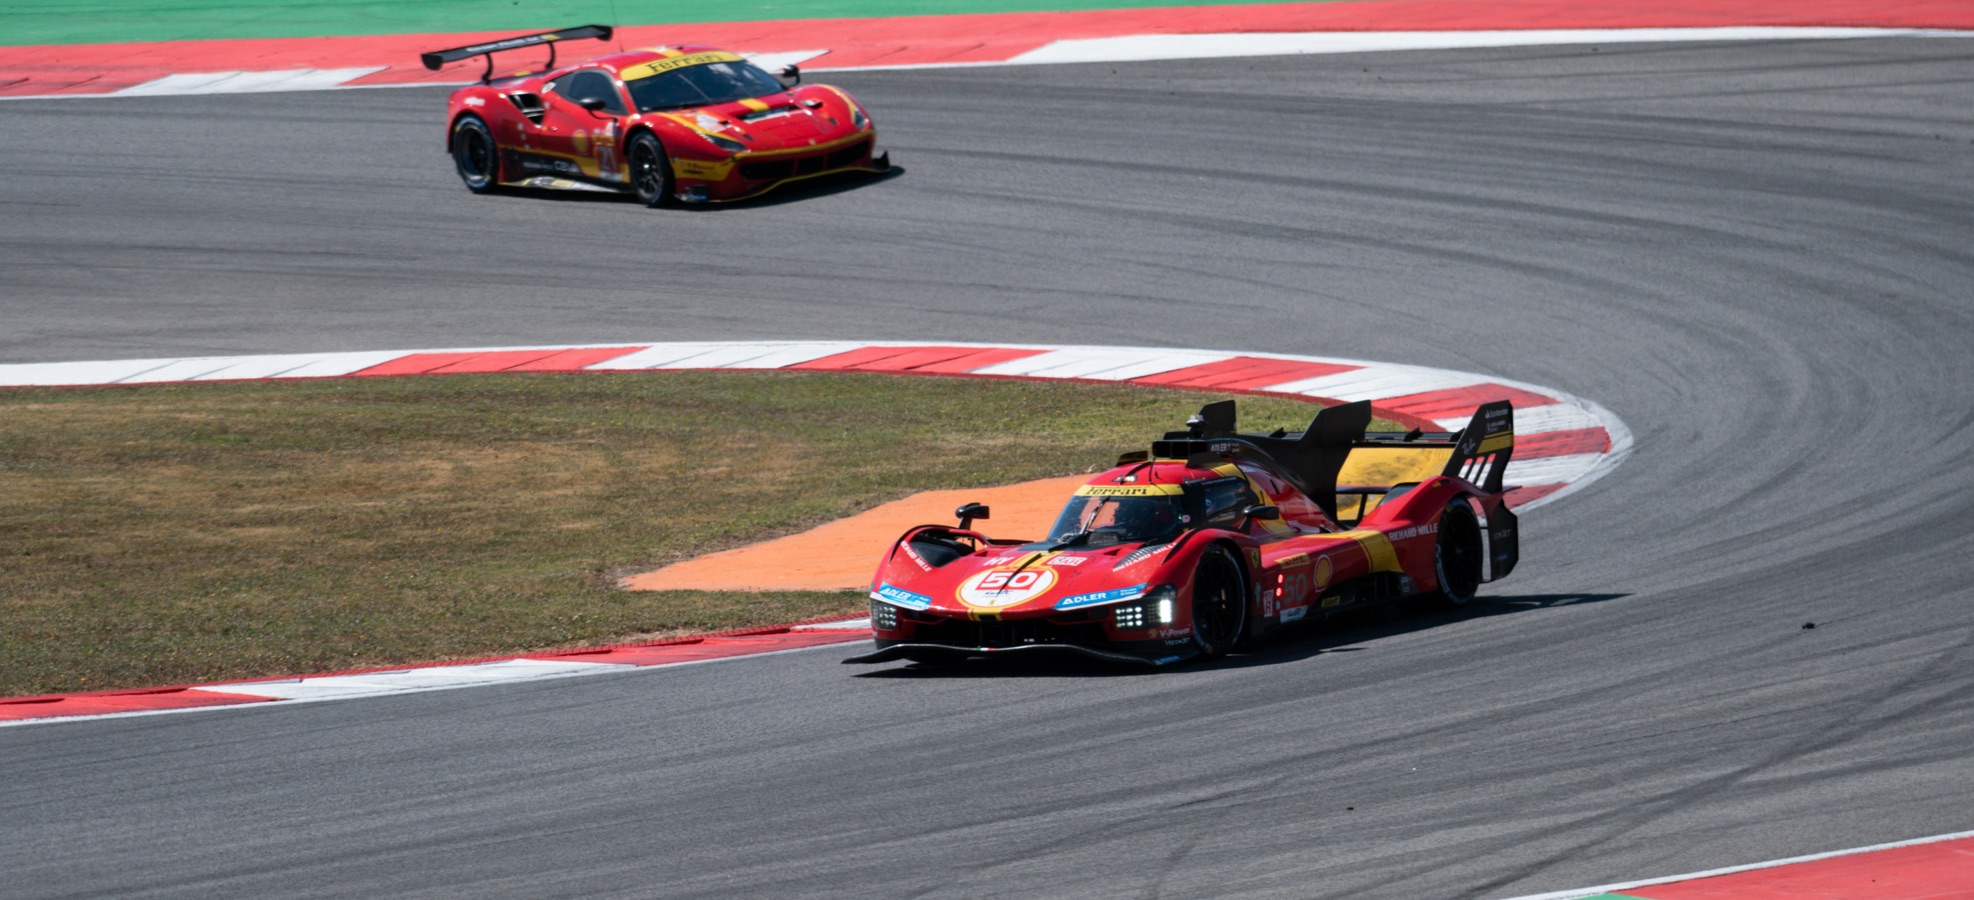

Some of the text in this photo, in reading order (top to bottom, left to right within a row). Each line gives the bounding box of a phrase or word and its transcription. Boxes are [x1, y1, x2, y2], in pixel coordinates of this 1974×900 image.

[646, 52, 724, 73] Ferrari
[597, 145, 617, 171] 21
[1086, 486, 1147, 496] Ferrari
[1389, 523, 1439, 540] RICHARD MILLE
[983, 557, 1015, 566] HY
[1112, 554, 1151, 573] RICHARD
[980, 572, 1038, 588] 50
[880, 587, 911, 600] ADLER
[1284, 573, 1307, 604] 50
[1062, 592, 1107, 605] ADLER
[1160, 628, 1190, 637] V-Power
